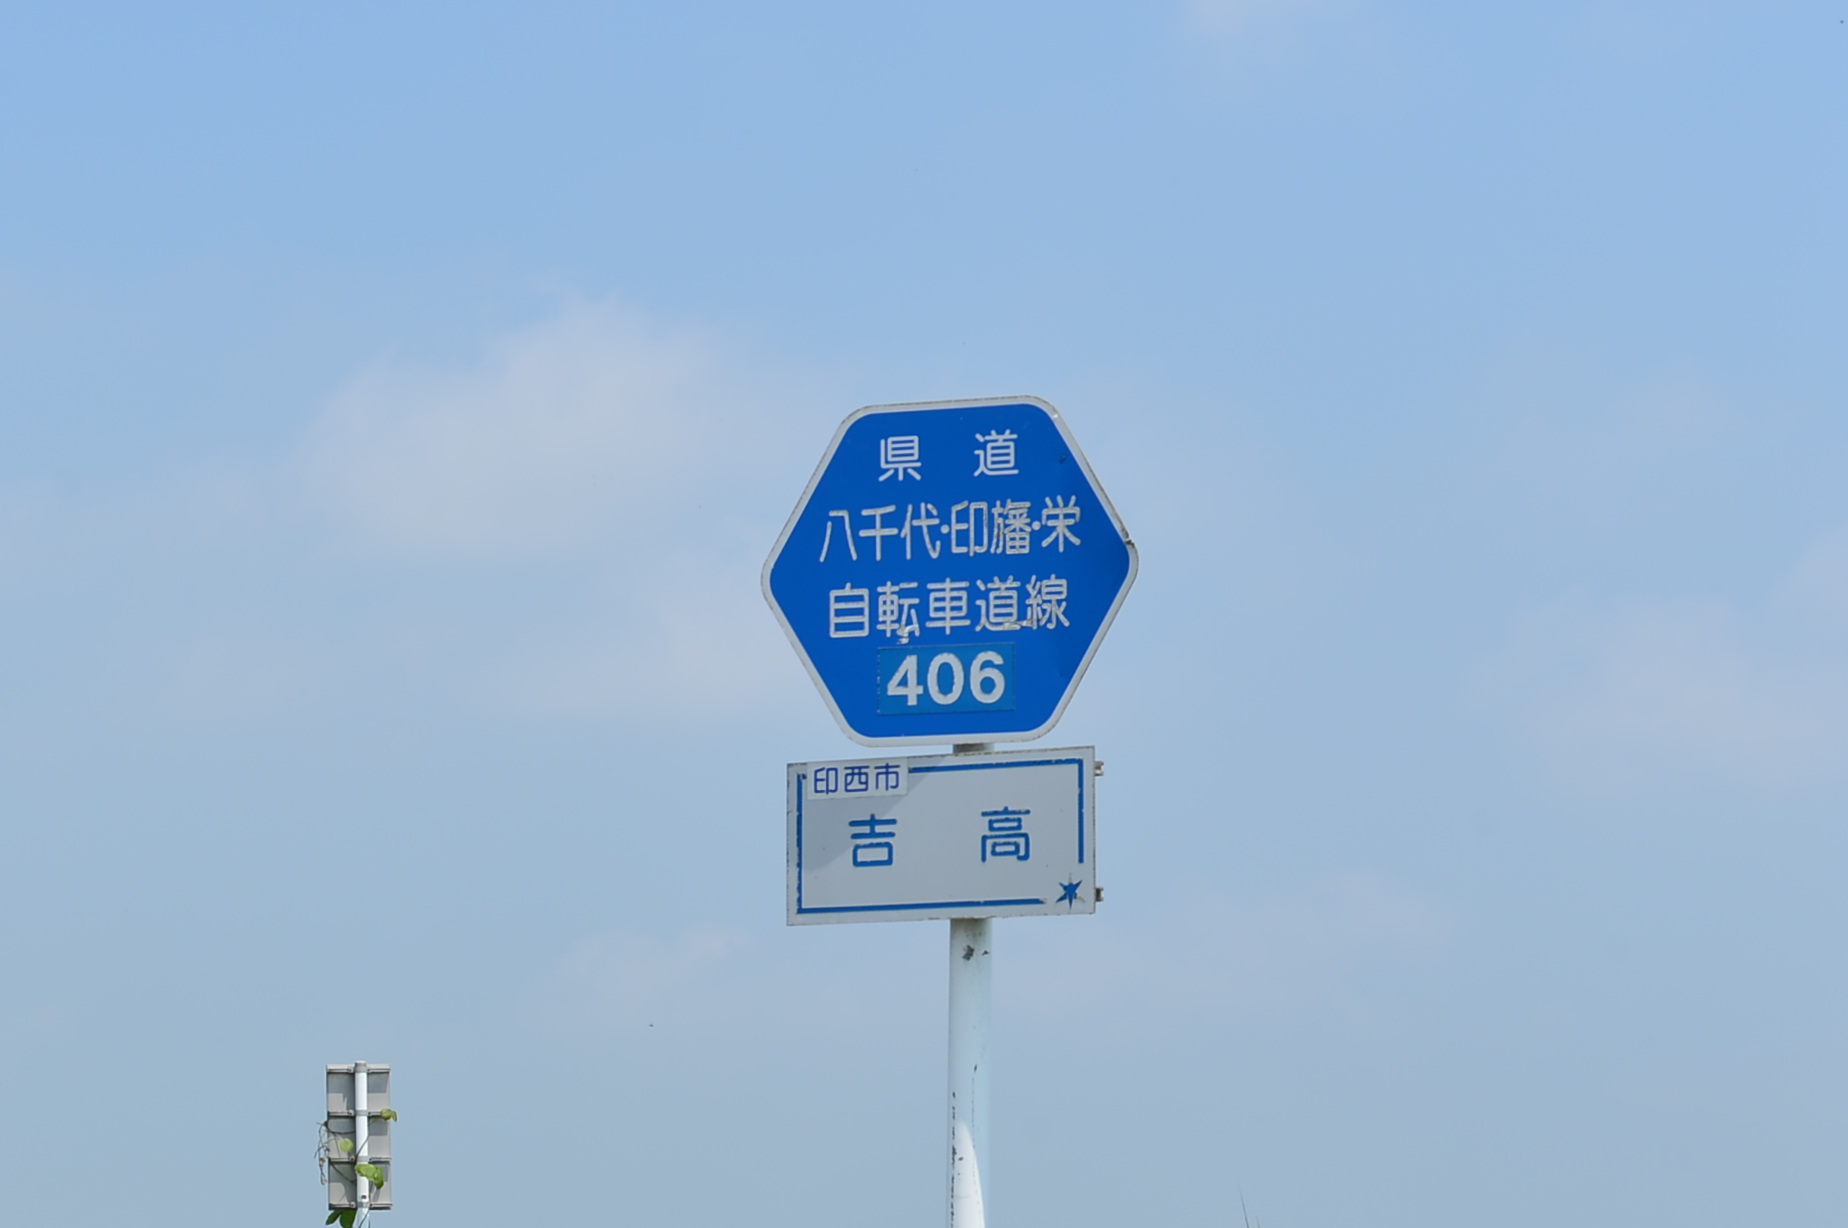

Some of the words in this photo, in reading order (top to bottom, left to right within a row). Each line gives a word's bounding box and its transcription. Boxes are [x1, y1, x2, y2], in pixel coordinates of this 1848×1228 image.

[829, 573, 1070, 638] 自転車道線
[886, 650, 1006, 706] 406
[813, 762, 901, 795] 印西市
